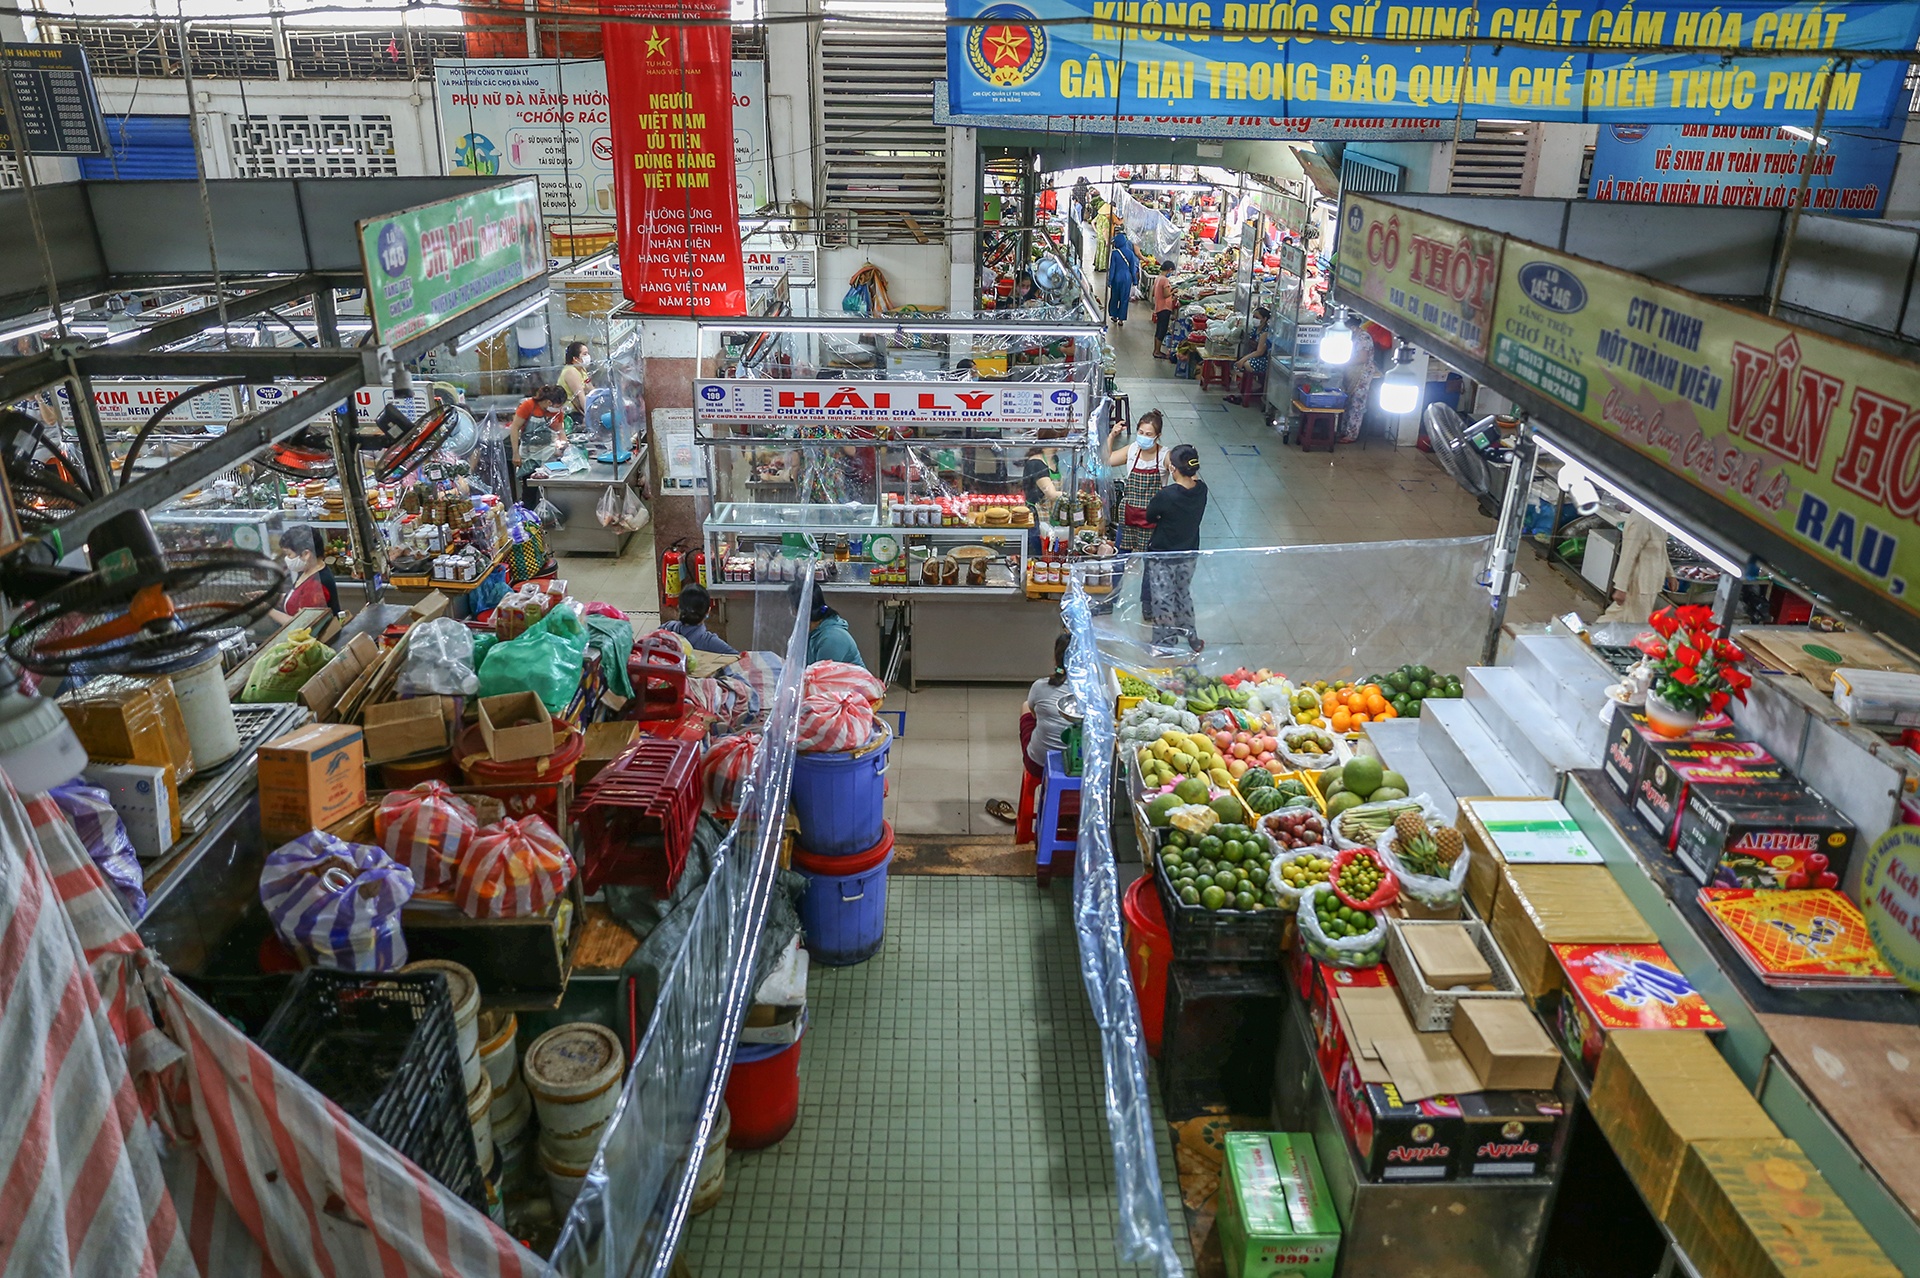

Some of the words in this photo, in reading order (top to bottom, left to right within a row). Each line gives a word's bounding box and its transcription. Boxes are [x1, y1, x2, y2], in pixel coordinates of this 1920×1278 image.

[1093, 0, 1211, 42] KHÔNG
[1222, 0, 1318, 50] ĐƯỢC
[1329, 0, 1381, 44] SỬ
[1385, 7, 1480, 52] DỤNG
[1490, 0, 1582, 47] CHẤT
[1587, 0, 1666, 48] CẤM
[1673, 7, 1743, 48] HÓA
[1752, 1, 1847, 50] CHẤT
[522, 68, 529, 76] LÝ
[522, 77, 539, 86] NẴNG
[1060, 53, 1127, 98] GÂY
[1137, 61, 1194, 106] HẠI
[1206, 61, 1318, 101] TRONG
[1329, 55, 1397, 102] BẢO
[1408, 57, 1499, 107] QUẢN
[1509, 55, 1575, 107] CHẾ
[1583, 56, 1658, 107] BIẾN
[1669, 65, 1756, 116] THỰC
[1763, 57, 1862, 111] PHẨM
[452, 94, 478, 109] PHỤ
[483, 92, 502, 105] NỮ
[505, 91, 526, 105] ĐÀ
[529, 88, 569, 106] NẴNG
[649, 89, 693, 109] NGƯỜI
[579, 108, 607, 123] RÁC
[639, 111, 668, 132] VIỆT
[672, 114, 706, 129] NAM
[528, 135, 535, 143] SỬ
[646, 133, 665, 149] ƯU
[669, 131, 701, 149] TIÊN
[545, 146, 554, 154] CÓ
[634, 150, 673, 169] DÙNG
[677, 150, 716, 169] HÀNG
[1655, 144, 1672, 175] VỆ
[1673, 150, 1705, 171] SINH
[1705, 151, 1725, 172] AN
[1727, 147, 1761, 174] TOÀN
[1764, 150, 1799, 179] THỰC
[575, 183, 582, 191] LỌ
[643, 170, 672, 192] VIỆT
[676, 173, 709, 188] NAM
[1596, 175, 1613, 200] LÀ
[1617, 176, 1659, 202] TRÁCH
[1703, 179, 1719, 206] VÀ
[1722, 178, 1762, 207] QUYỀN
[1814, 187, 1840, 214] MỌI
[1840, 184, 1880, 210] NGƯỜI
[645, 207, 685, 220] HƯỞNG
[688, 207, 713, 219] ỨNG
[637, 224, 685, 234] CHƯƠNG
[690, 222, 723, 234] TRÌNH
[420, 224, 450, 283] CHỊ
[447, 205, 476, 270] BẢY
[650, 237, 681, 251] NHẬN
[685, 237, 711, 250] DIỆN
[1367, 214, 1400, 272] CÔ
[673, 251, 697, 265] VIỆT
[701, 253, 725, 263] NAM
[662, 268, 677, 280] TỰ
[641, 281, 672, 292] HÀNG
[675, 280, 700, 294] VIỆT
[702, 282, 727, 292] NAM
[1530, 277, 1573, 311] 145-146
[659, 295, 683, 306] NĂM
[686, 297, 711, 306] 2019
[1518, 303, 1547, 326] TẦNG
[1547, 316, 1575, 338] TRỆT
[1626, 297, 1659, 334] CTY
[1658, 306, 1704, 352] TNHH
[1505, 317, 1541, 345] CHỢ
[1542, 335, 1584, 367] HÀN
[1596, 328, 1628, 368] MỘT
[1627, 342, 1680, 391] THÀNH
[1678, 364, 1723, 411] VIÊN
[94, 391, 129, 404] KIM
[779, 387, 890, 408] HẢI
[918, 391, 994, 410] LÝ
[1727, 331, 1845, 474] VÂN
[128, 407, 150, 415] NEM
[1602, 386, 1645, 433] Chuyên
[1647, 409, 1681, 464] Cung
[1683, 430, 1716, 476] Cấp
[1741, 459, 1761, 496] &
[1795, 491, 1907, 596] RAU,
[1641, 779, 1670, 813] Apple
[1735, 832, 1820, 851] APPLE
[1877, 885, 1909, 927] Mua
[1388, 1143, 1450, 1162] Apple
[1477, 1140, 1539, 1158] Apple
[1275, 1254, 1309, 1265] 999
